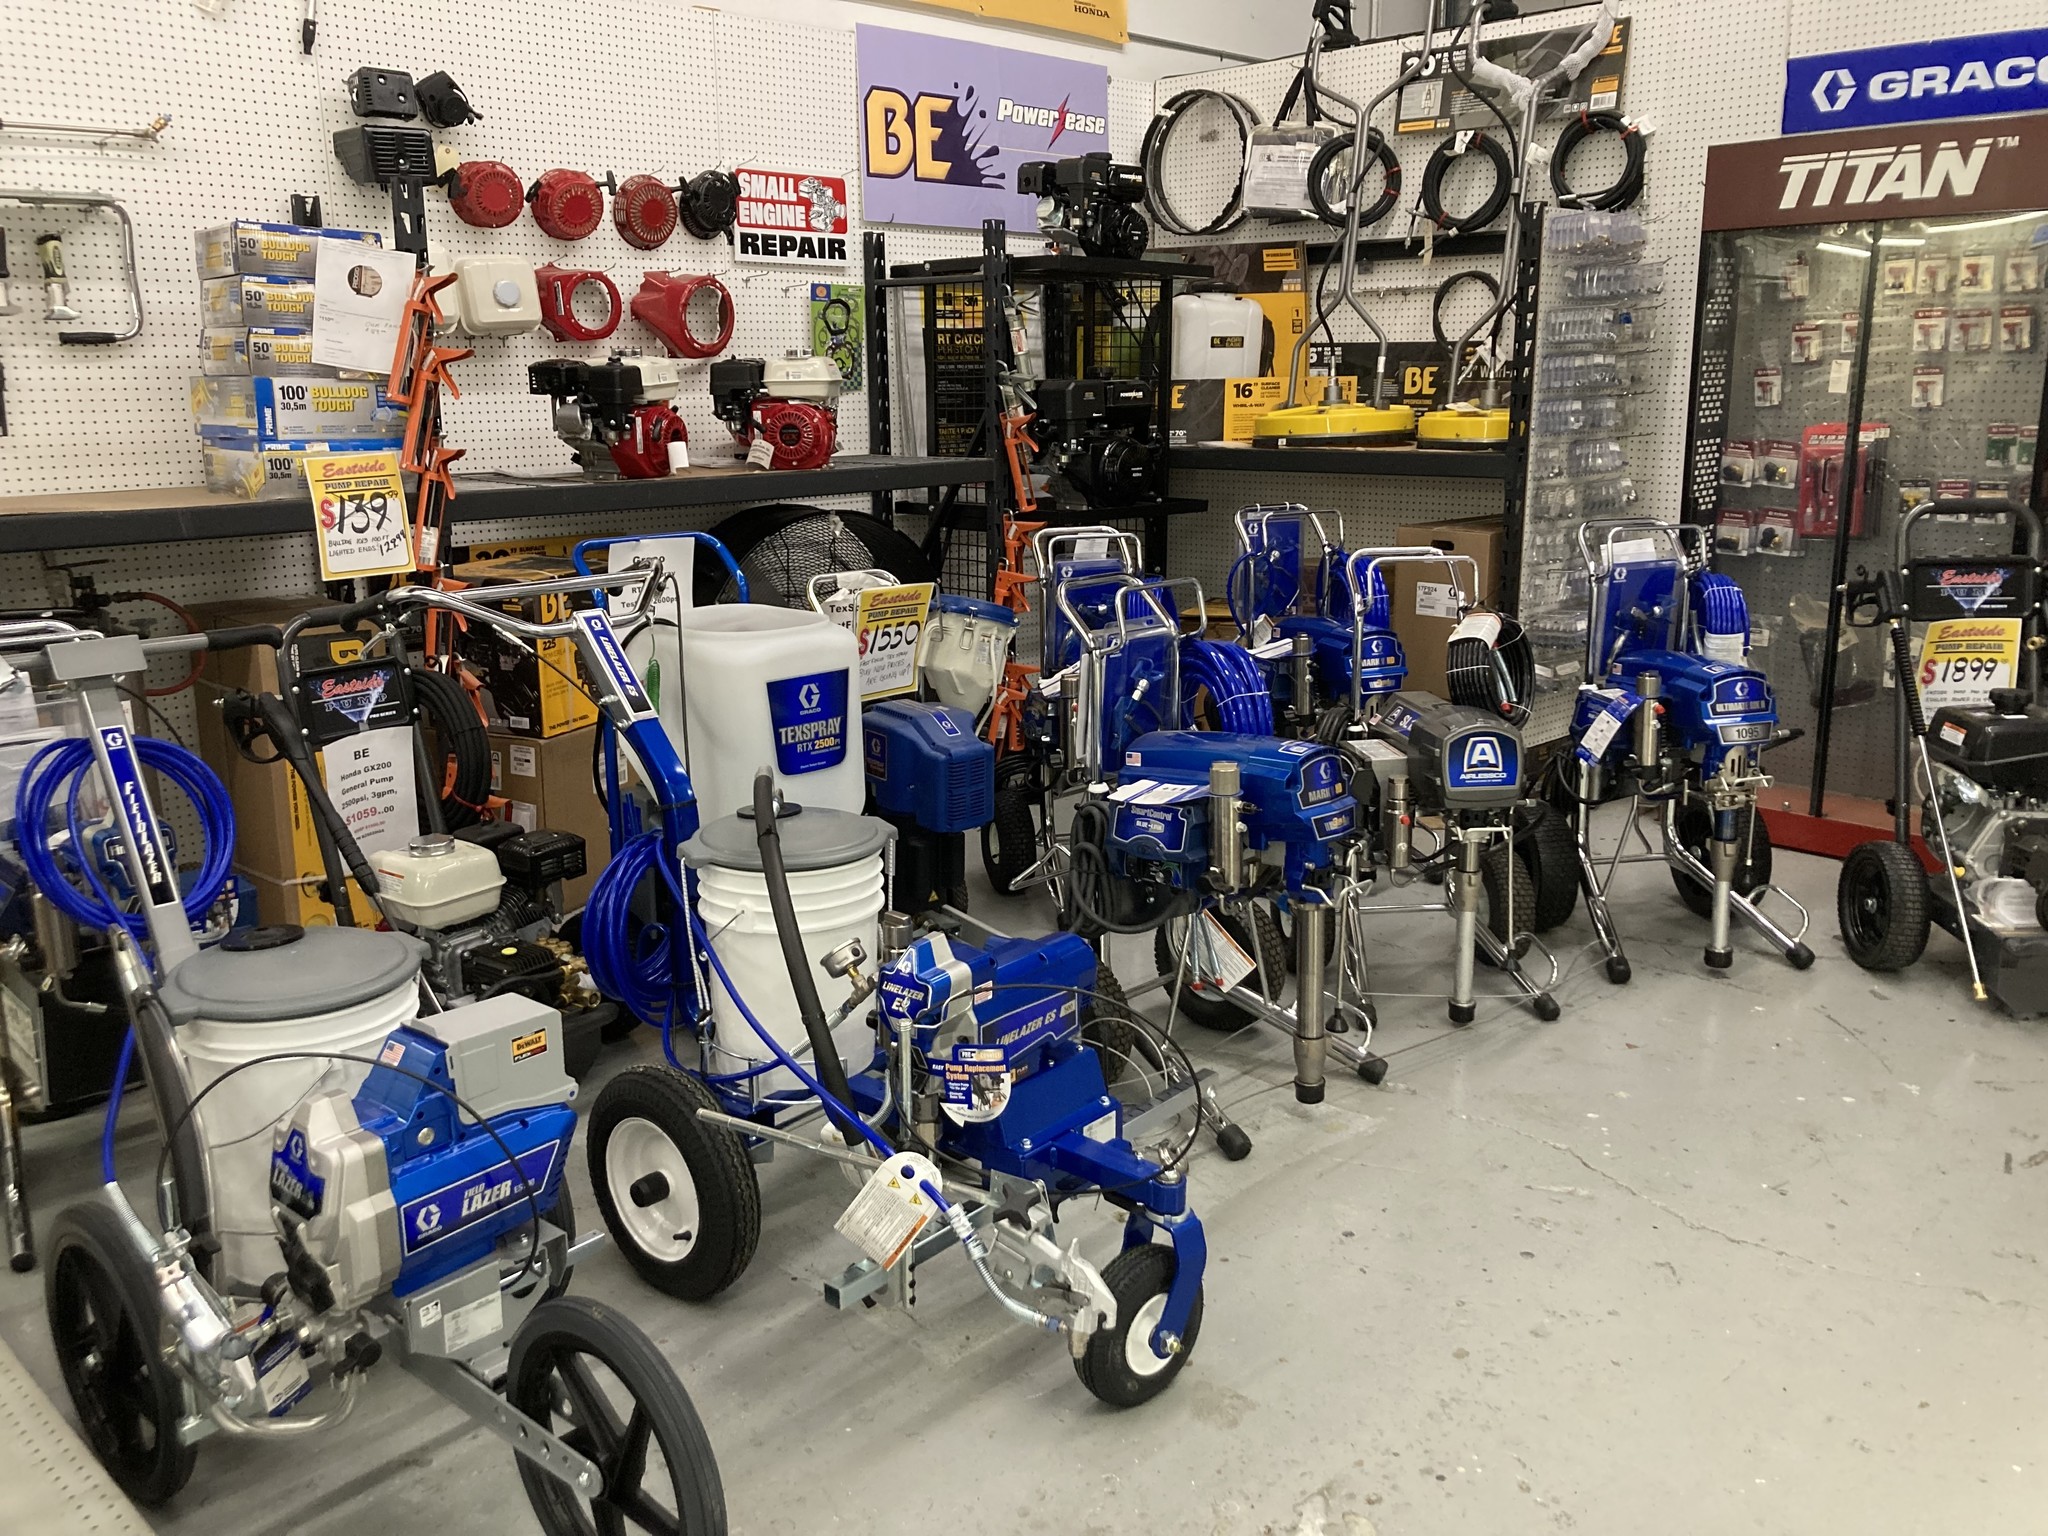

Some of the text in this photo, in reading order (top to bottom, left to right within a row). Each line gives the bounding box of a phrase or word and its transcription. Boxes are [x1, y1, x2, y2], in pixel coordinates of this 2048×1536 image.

[1074, 5, 1110, 18] HONDA
[1868, 56, 2048, 102] GRAC
[865, 86, 954, 180] BE
[1779, 138, 1994, 210] TITAN
[738, 172, 798, 202] SMALL
[738, 200, 806, 228] ENGINE
[261, 240, 310, 252] BULLDOG
[740, 232, 847, 260] REPAIR
[261, 251, 300, 262] TOUGH
[267, 302, 305, 313] TOUGH
[1404, 366, 1439, 395] BE
[278, 385, 368, 400] 100' BULLDOG
[280, 400, 355, 412] 30,5m TOUGH
[268, 458, 293, 471] 100'
[322, 460, 387, 478] Eastside
[325, 479, 389, 490] PUMP REPAIR
[1940, 569, 2003, 585] Eastside
[870, 590, 921, 608] Eastside
[868, 606, 918, 619] PUMP REPAIR
[1938, 625, 2006, 640] Eastside
[543, 640, 556, 651] 225
[1935, 642, 2004, 651] PUMP REPAIR
[600, 635, 631, 683] LINELAZER
[322, 674, 385, 699] Eastside
[799, 707, 821, 716] GRACO
[779, 717, 841, 745] TEXSPRAY
[1736, 727, 1759, 739] 1095
[354, 748, 370, 760] BE
[797, 743, 813, 753] RTX
[340, 761, 392, 781] Honda GX200
[1459, 772, 1507, 780] AIRLESSCO
[342, 775, 394, 795] General Pump
[371, 788, 397, 799] 3gpm,
[1308, 787, 1331, 802] MARK
[1131, 805, 1173, 821] SmartControl
[882, 981, 925, 1001] LINELAZER
[1044, 1010, 1057, 1025] ES
[945, 1064, 962, 1073] Pump
[964, 1064, 1006, 1073] Replacement
[946, 1072, 969, 1082] System
[465, 1183, 485, 1198] FIELD
[462, 1180, 512, 1217] LAZER
